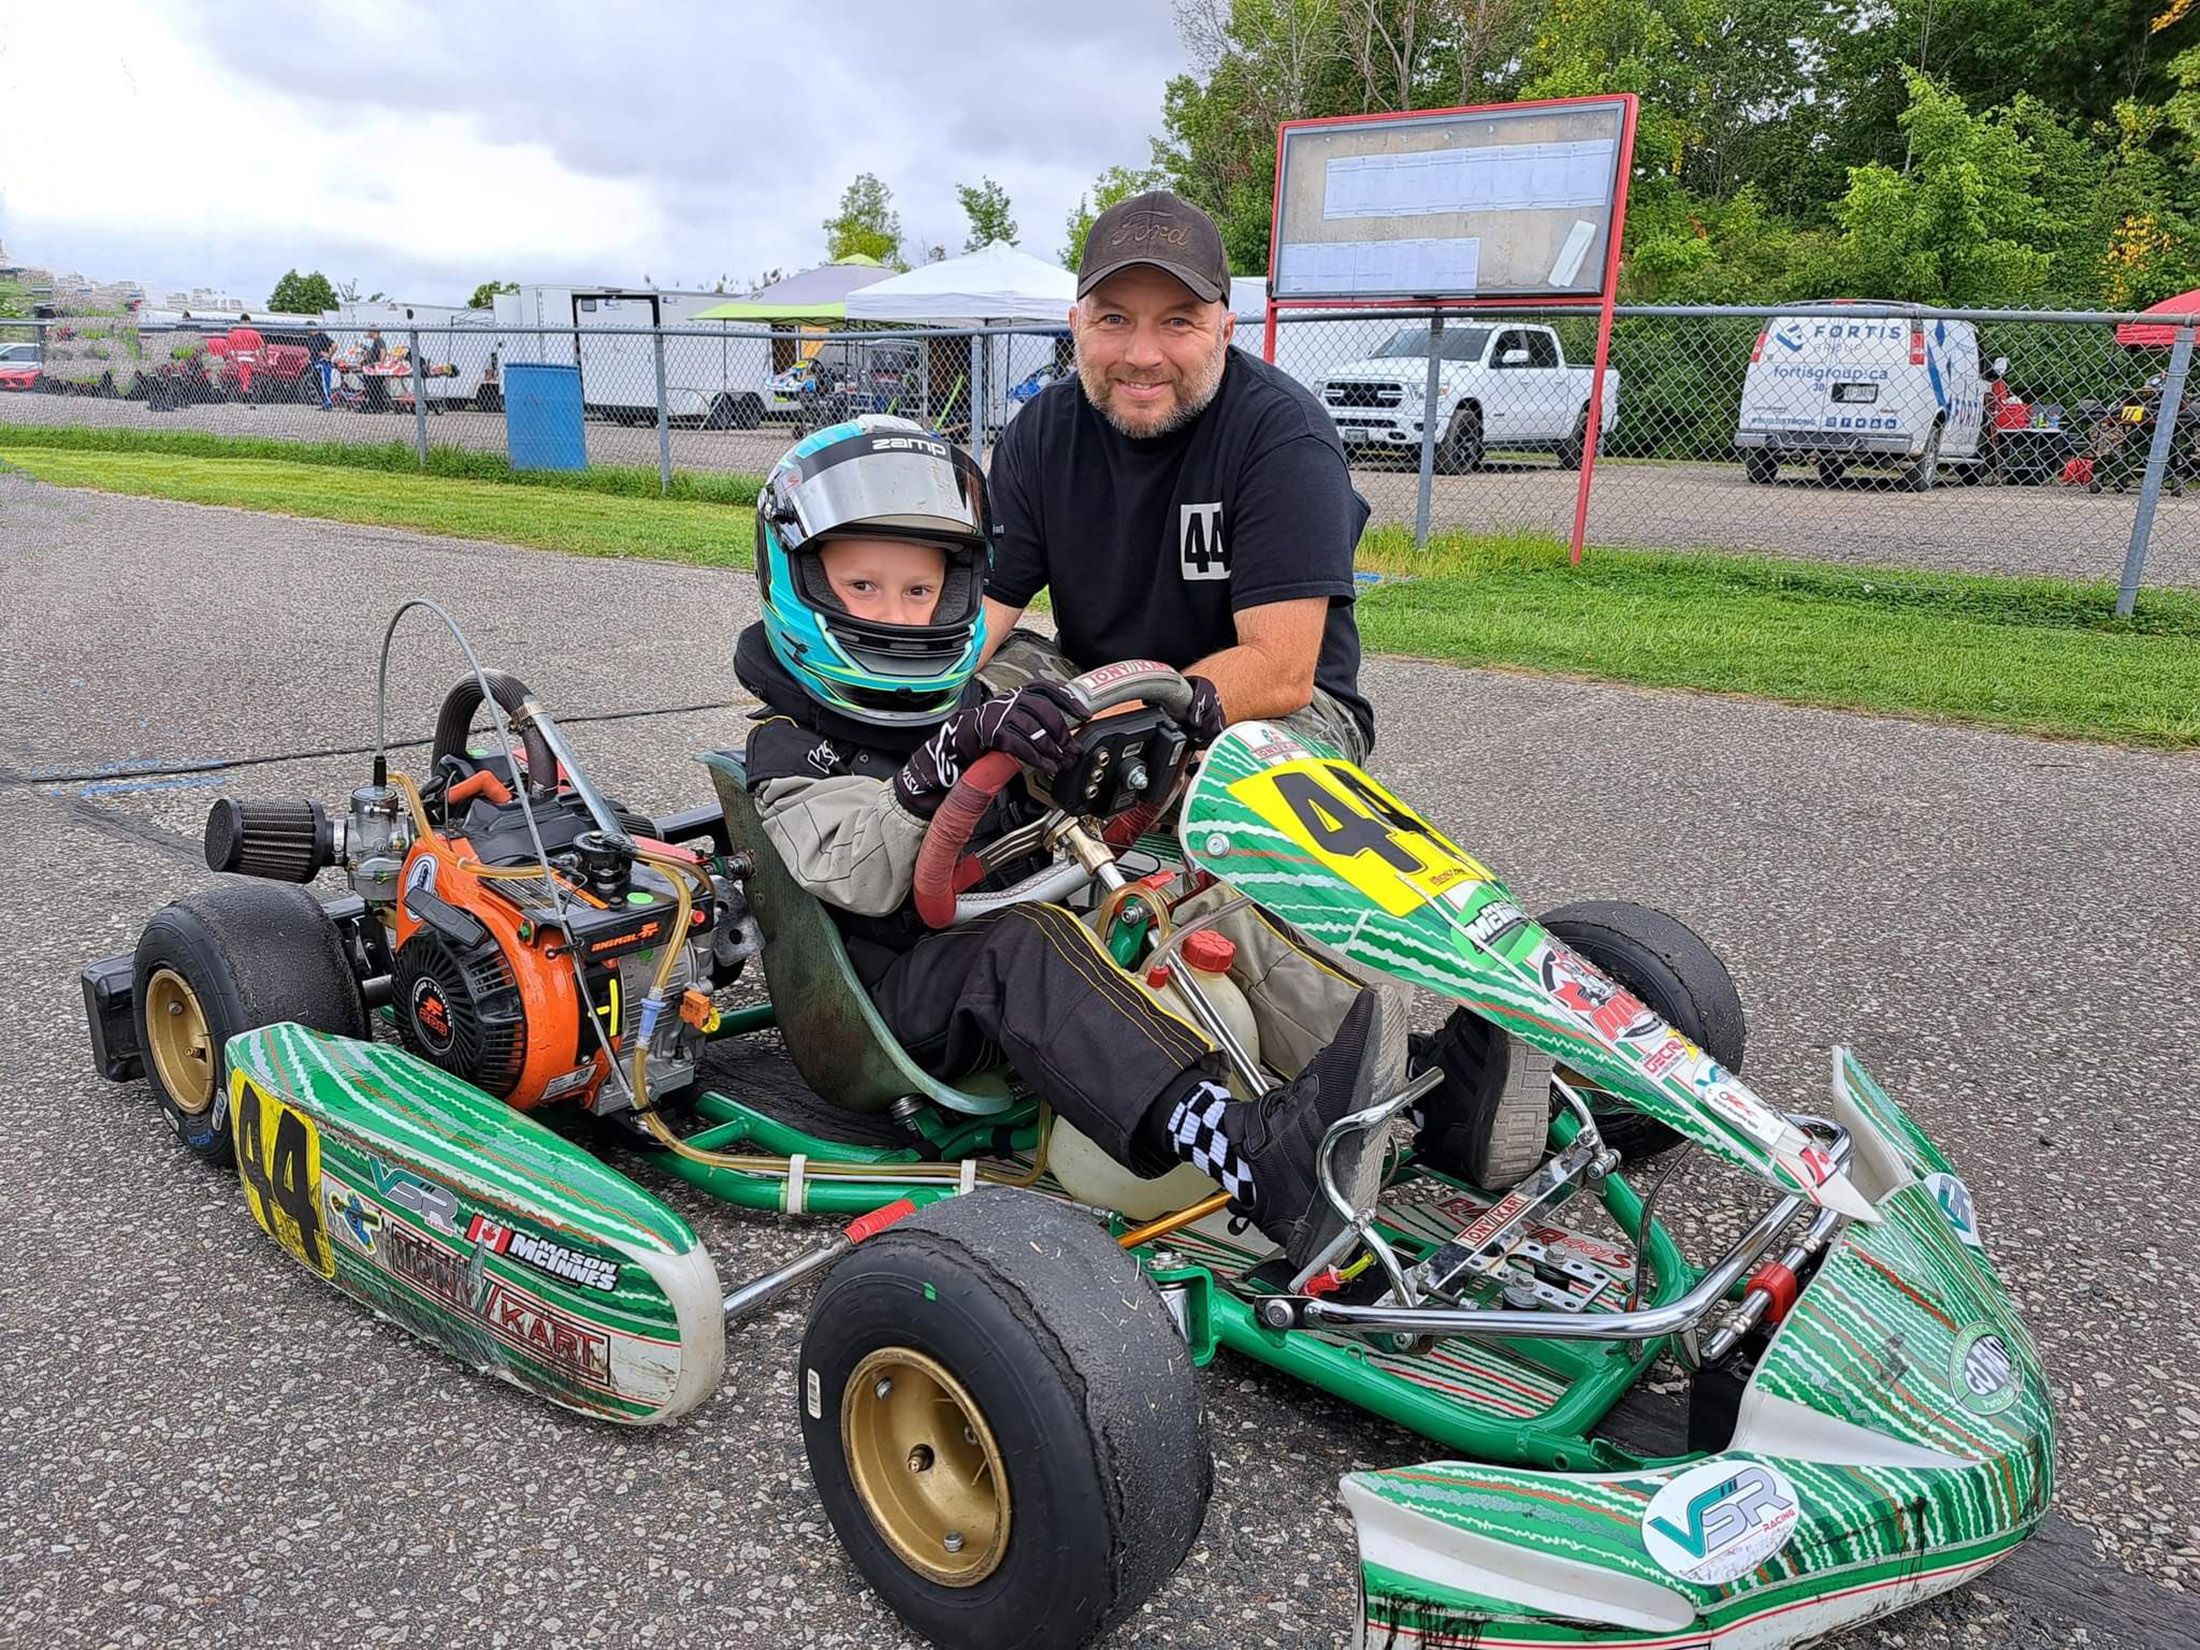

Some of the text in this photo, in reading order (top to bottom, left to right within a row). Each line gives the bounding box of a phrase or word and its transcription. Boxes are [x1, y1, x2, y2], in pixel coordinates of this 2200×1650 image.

[1110, 210, 1191, 246] Ford
[1813, 325, 1901, 340] FORTIS
[1773, 365, 1888, 381] fortisgroup.ca
[872, 437, 946, 457] zamp
[1184, 512, 1230, 573] 44
[239, 1081, 326, 1271] 44
[1466, 1193, 1527, 1243] TONY KART
[538, 1237, 618, 1274] MASON
[501, 1300, 604, 1370] KART
[1648, 1467, 1794, 1559] VSR
[1763, 1509, 1796, 1532] RACING
